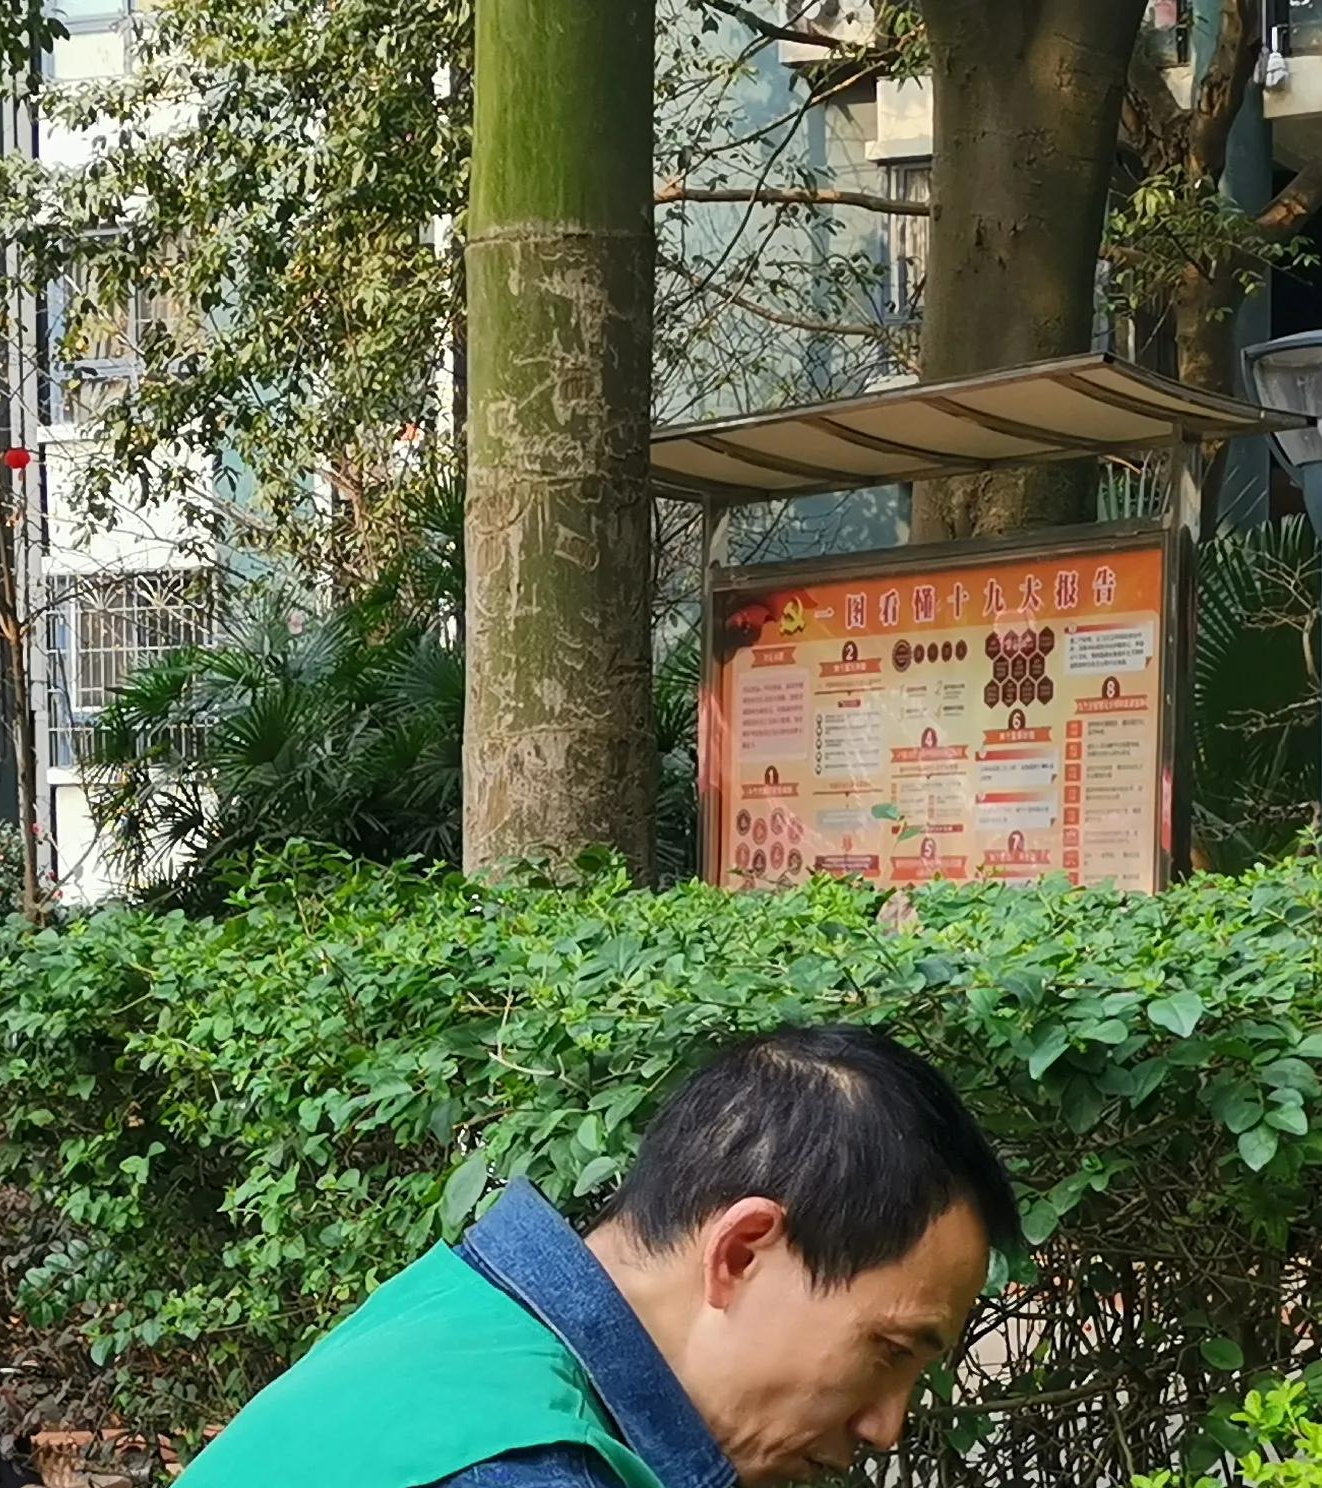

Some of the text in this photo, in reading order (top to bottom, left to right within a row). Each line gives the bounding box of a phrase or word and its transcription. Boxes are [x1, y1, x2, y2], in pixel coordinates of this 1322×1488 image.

[814, 566, 1116, 629] 一图看懂十九大报告
[845, 644, 854, 660] 2
[1106, 680, 1115, 698] 8
[1012, 712, 1021, 727] 6
[925, 730, 933, 747] 4
[1012, 834, 1020, 849] 7
